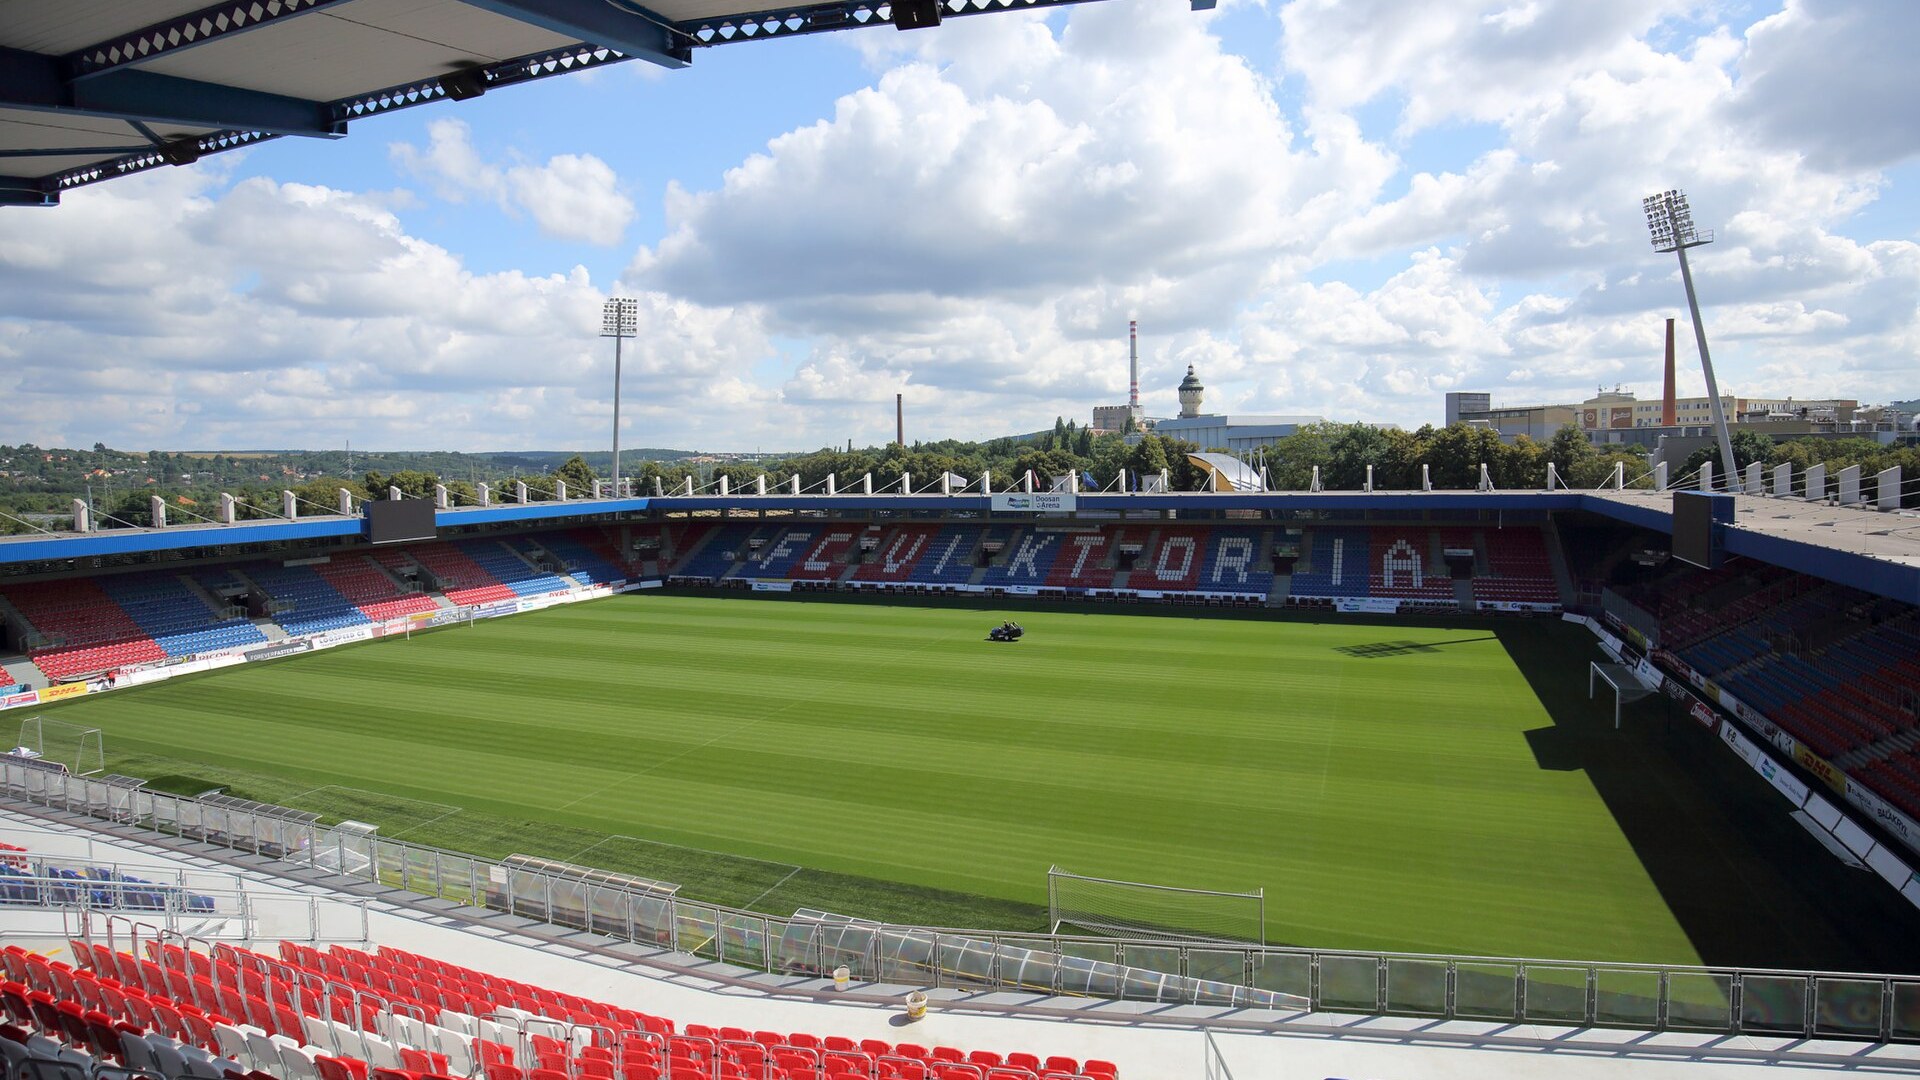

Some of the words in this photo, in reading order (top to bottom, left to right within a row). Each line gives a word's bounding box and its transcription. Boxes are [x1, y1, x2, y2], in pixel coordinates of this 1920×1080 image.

[759, 532, 852, 572] FC
[883, 533, 1423, 588] VIKTORIA
[199, 651, 230, 661] RICOH
[48, 686, 77, 697] DHL
[1802, 752, 1833, 783] DHL
